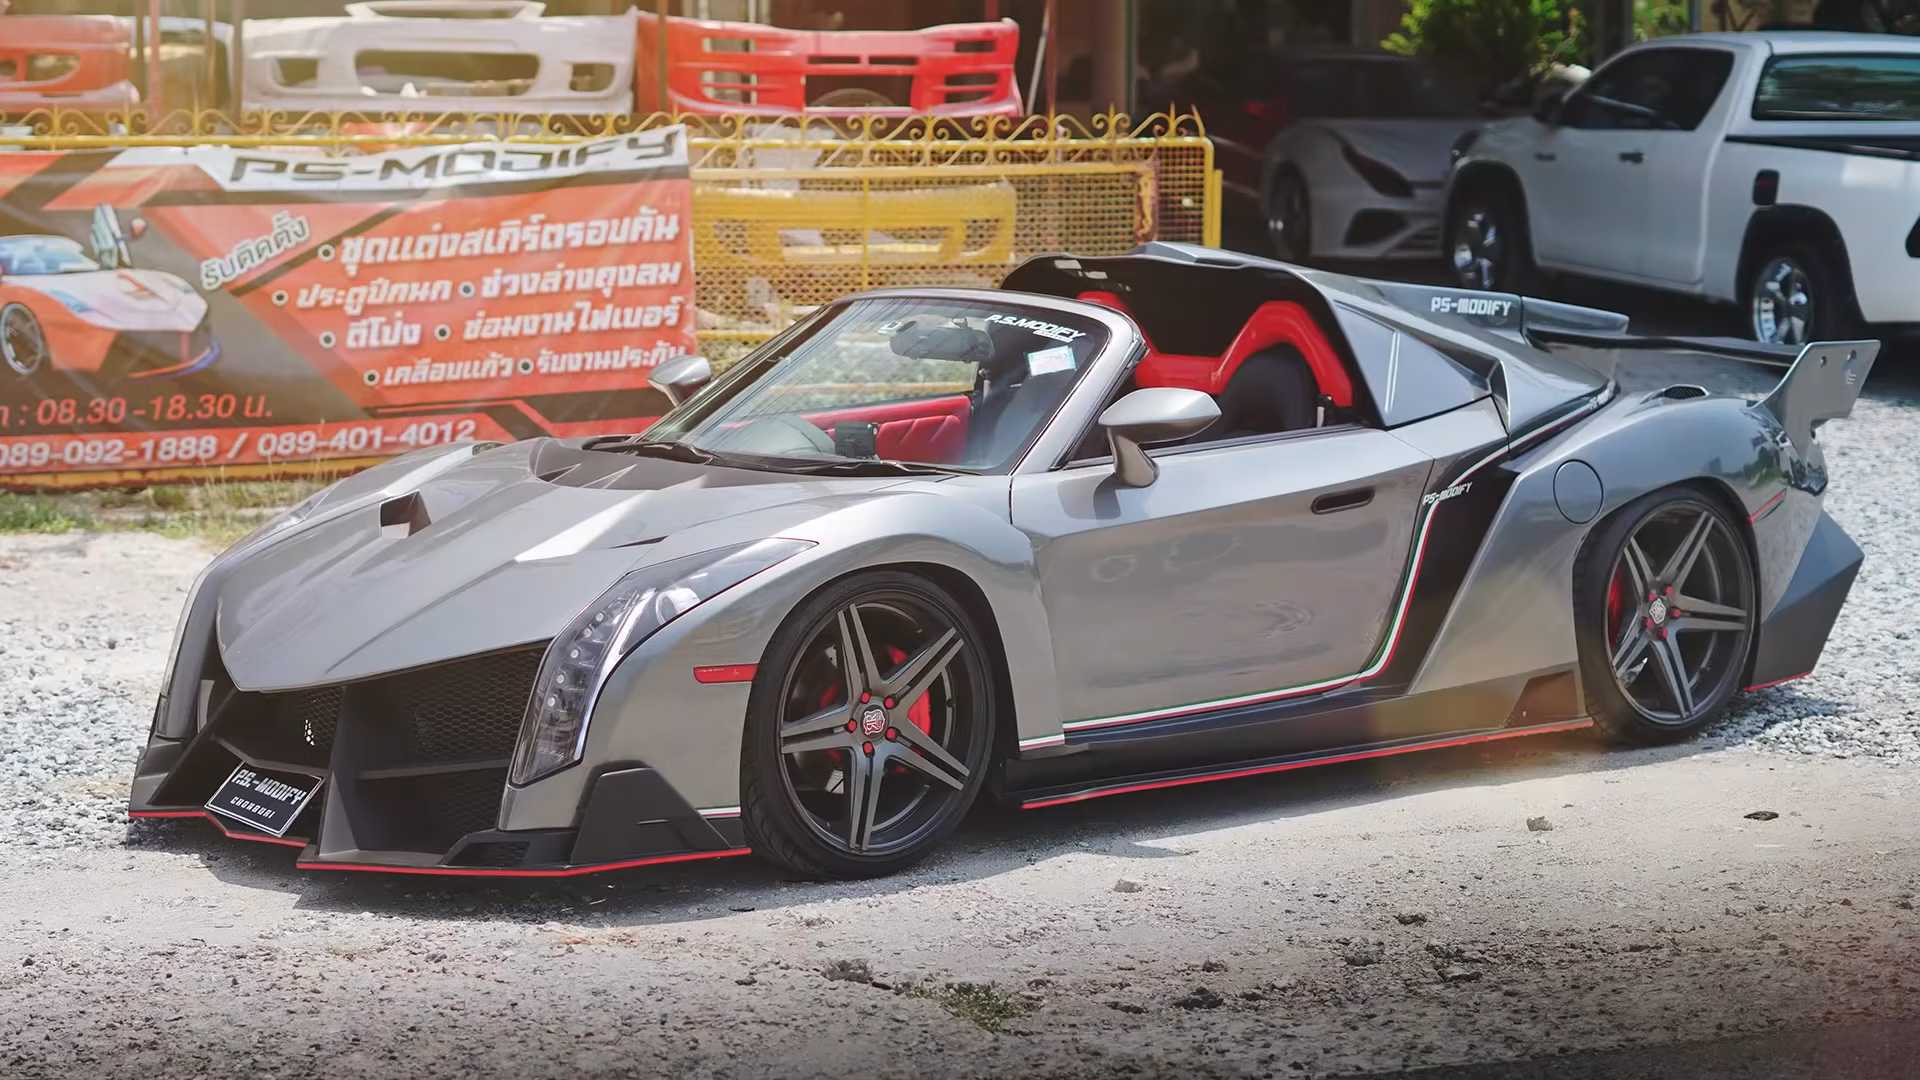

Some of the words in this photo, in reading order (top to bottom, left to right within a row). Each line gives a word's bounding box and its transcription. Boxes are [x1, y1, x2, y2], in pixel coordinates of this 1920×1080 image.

[230, 131, 678, 183] PS-MODIFY
[1431, 297, 1512, 316] PS-MODIFY
[257, 419, 476, 456] 089-401-4012
